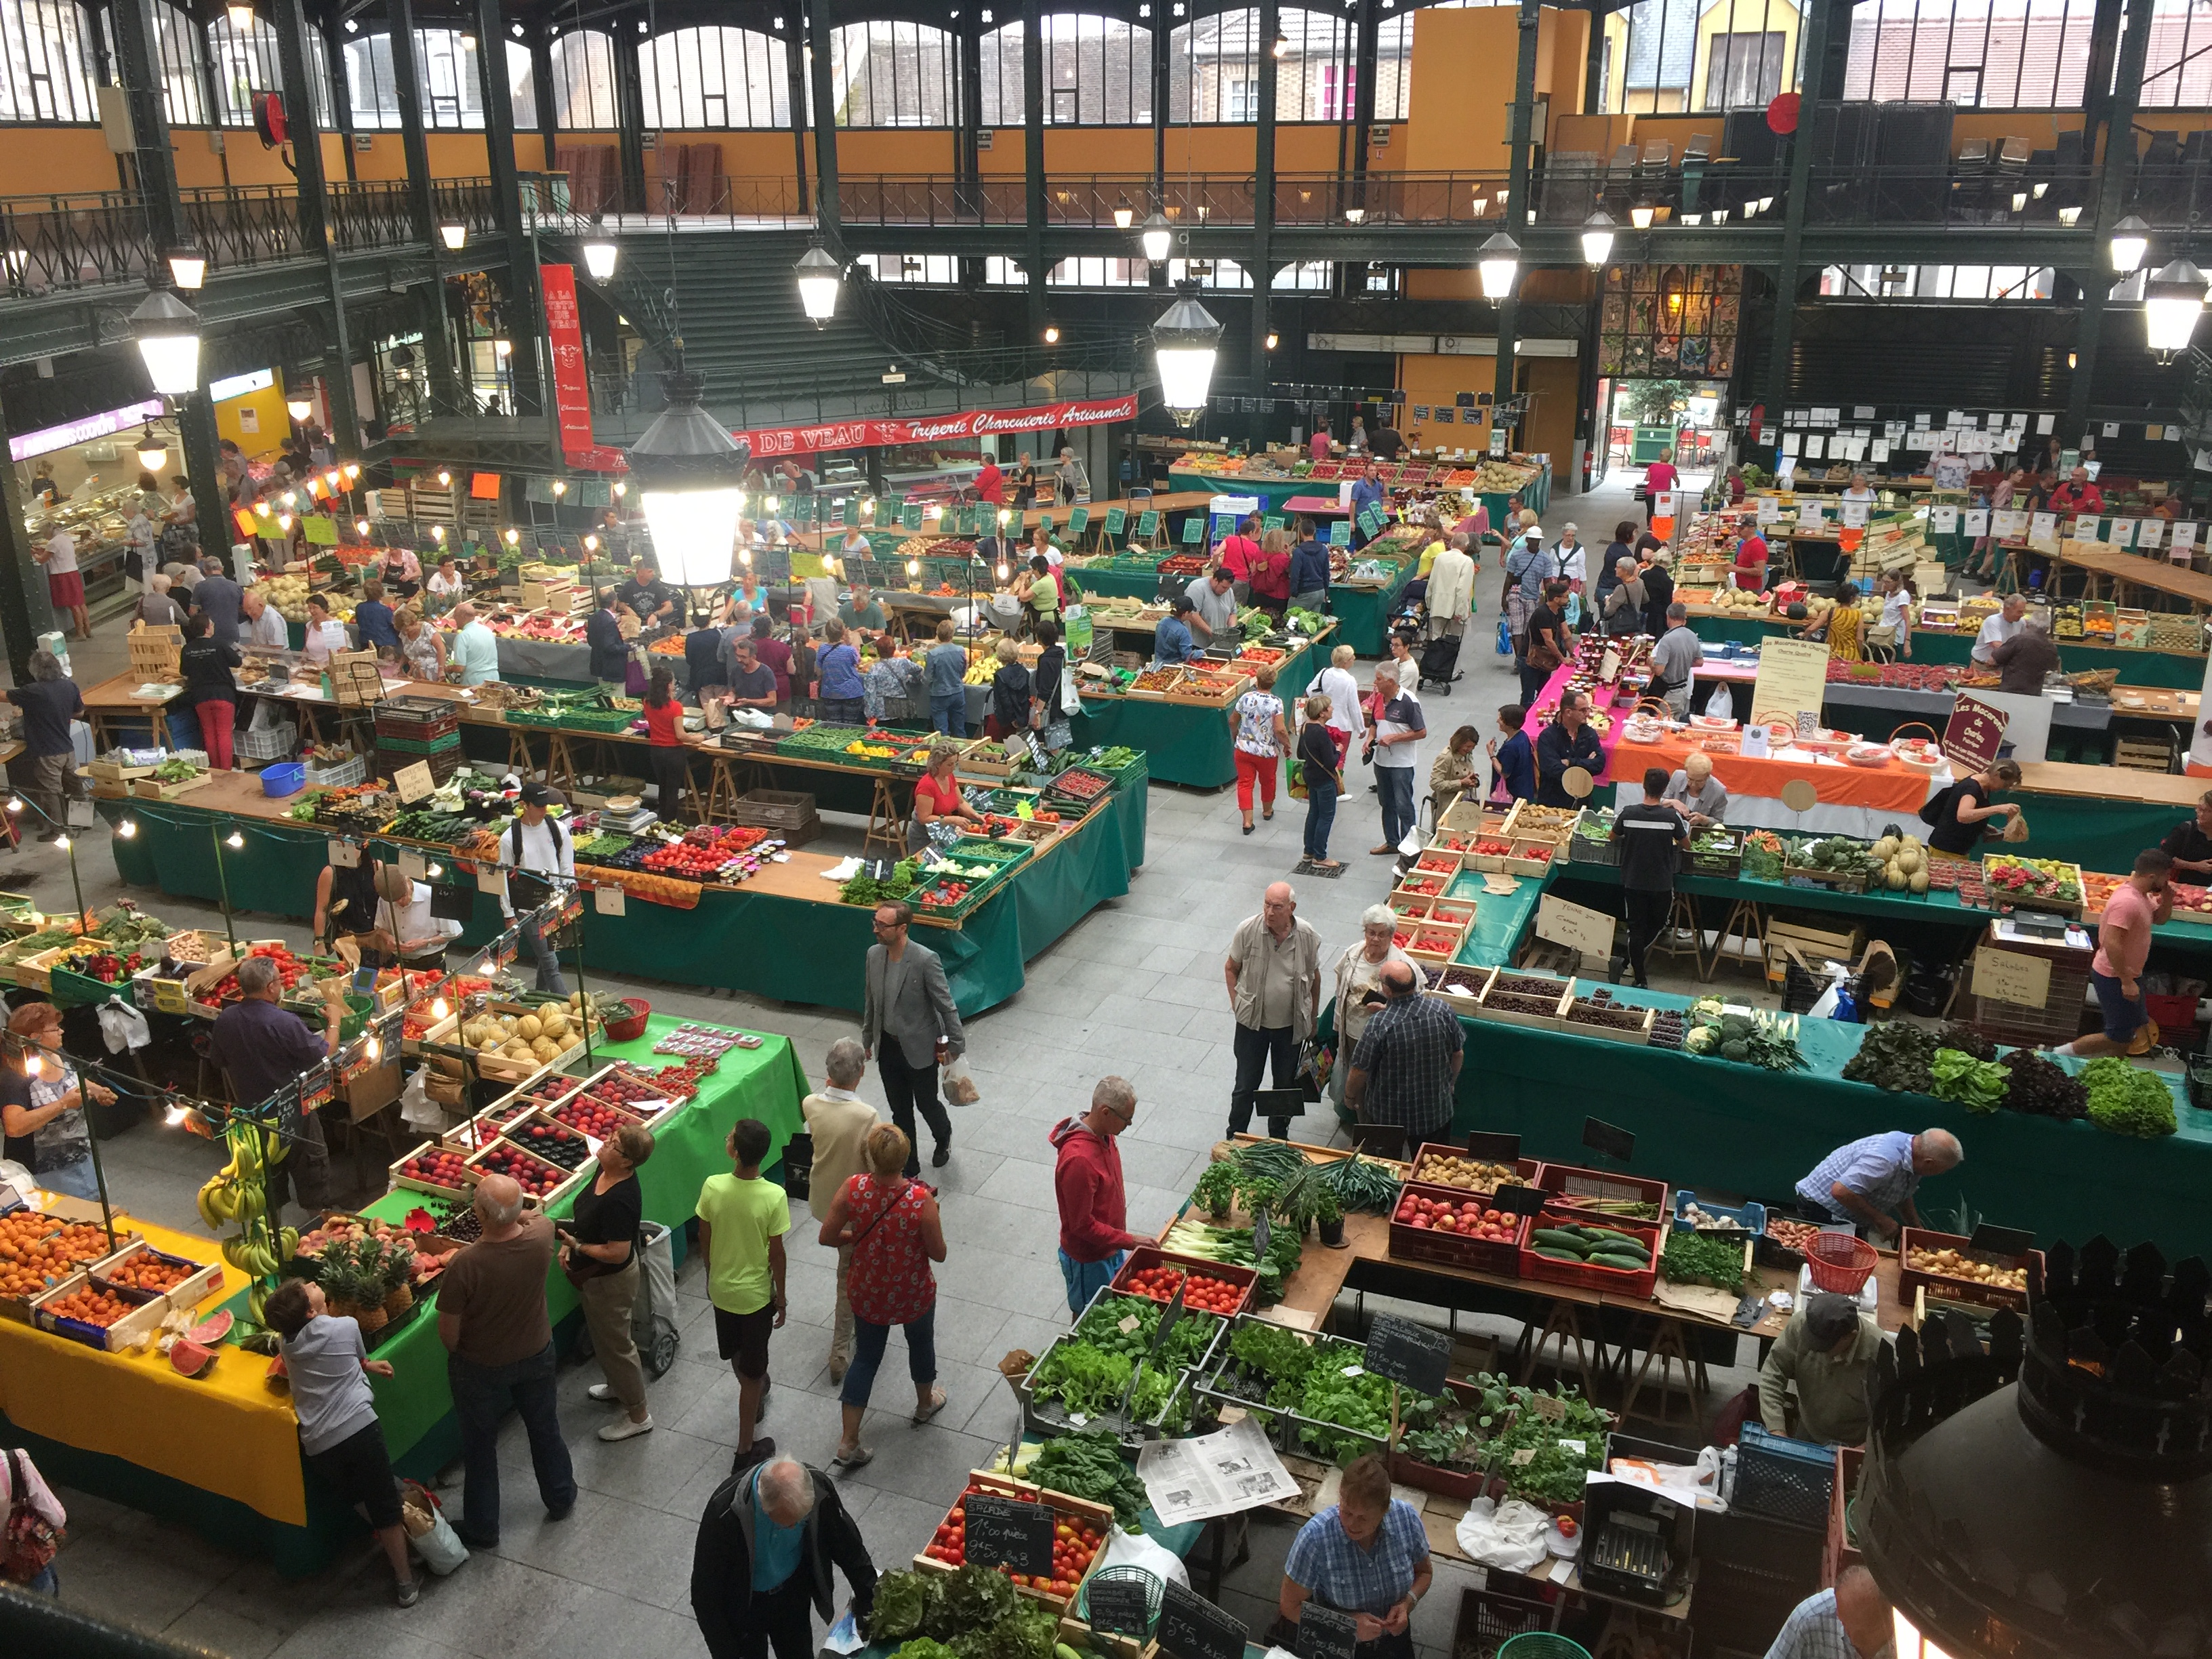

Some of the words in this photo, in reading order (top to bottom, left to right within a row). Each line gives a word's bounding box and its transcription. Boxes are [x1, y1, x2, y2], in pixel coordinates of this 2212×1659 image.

[554, 310, 569, 320] DE
[550, 319, 577, 329] VEAU
[613, 453, 629, 468] A
[760, 432, 794, 453] DE
[802, 425, 865, 449] VEAU
[906, 420, 967, 441] Triperie
[972, 413, 1057, 434] Charcuterie
[1059, 402, 1132, 425] Artisanale
[1955, 703, 1970, 712] Les
[1972, 704, 2004, 733] Macarons
[1973, 717, 1984, 728] de
[968, 1504, 1012, 1517] SALADE
[1301, 1612, 1350, 1633] COURGETTE
